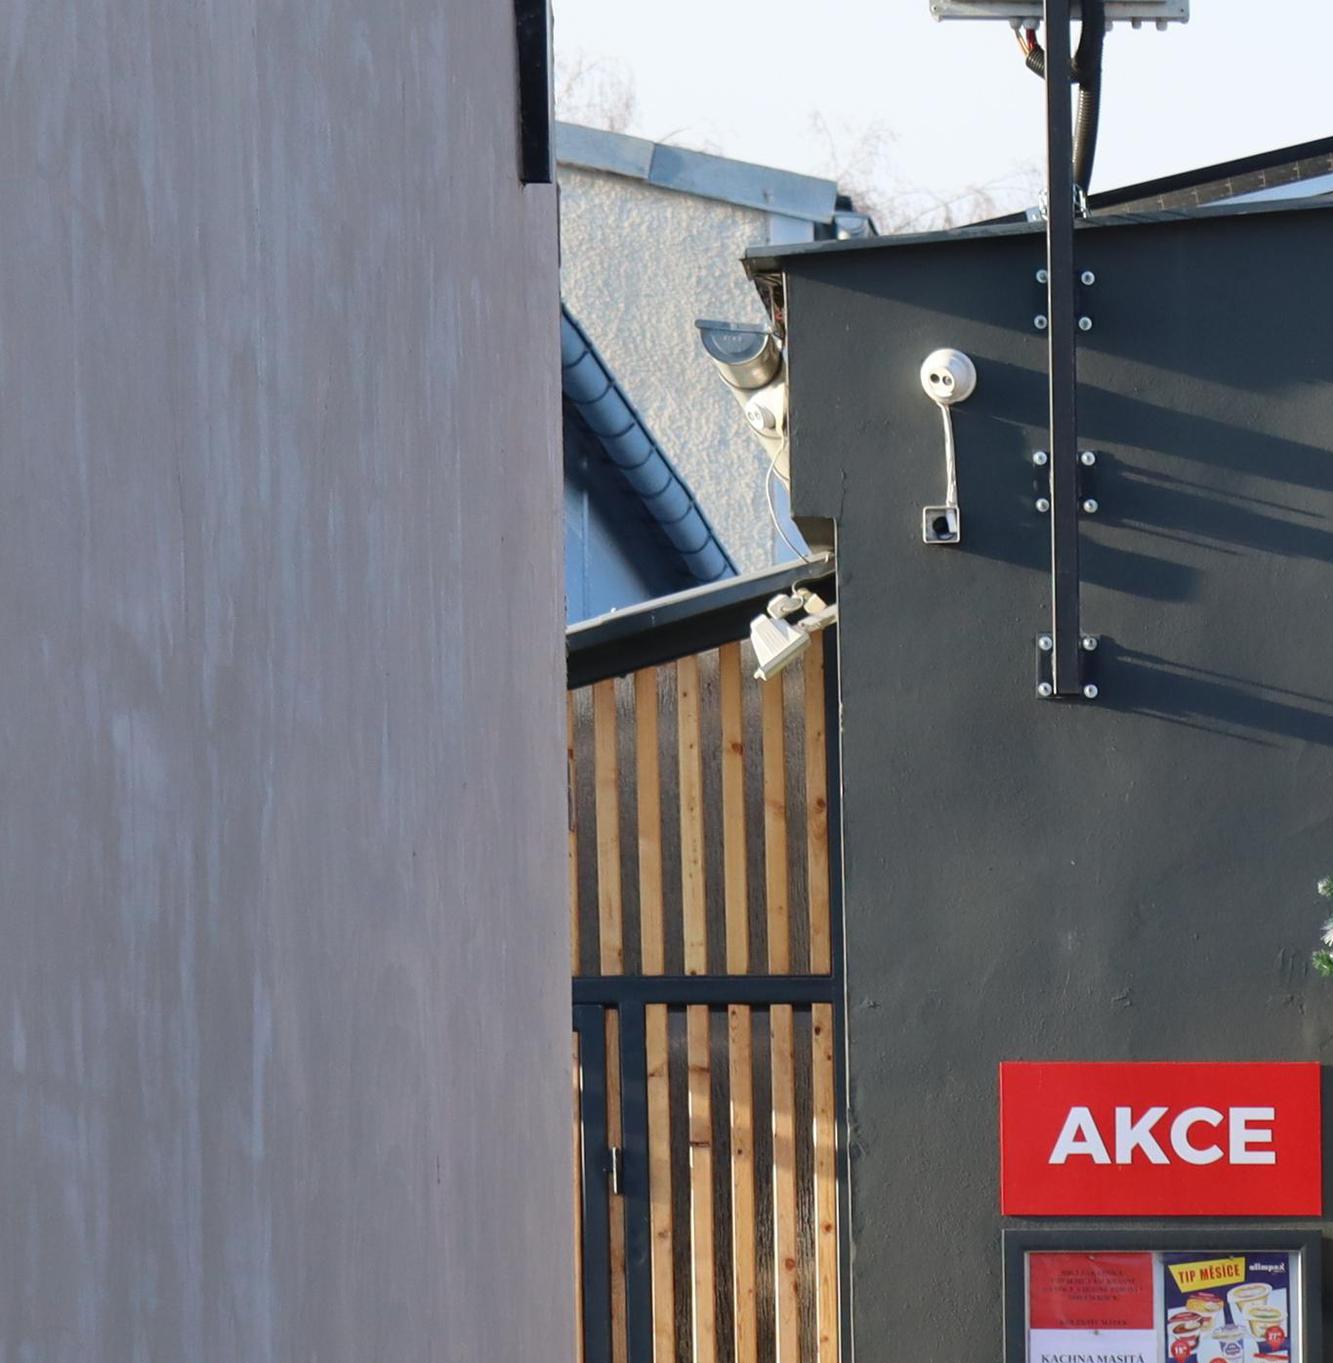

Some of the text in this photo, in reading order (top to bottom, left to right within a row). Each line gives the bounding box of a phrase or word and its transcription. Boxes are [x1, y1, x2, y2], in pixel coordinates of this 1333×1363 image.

[1048, 1106, 1276, 1165] AKCE
[1178, 1270, 1196, 1284] TIP
[1041, 1353, 1095, 1363] KACHNA
